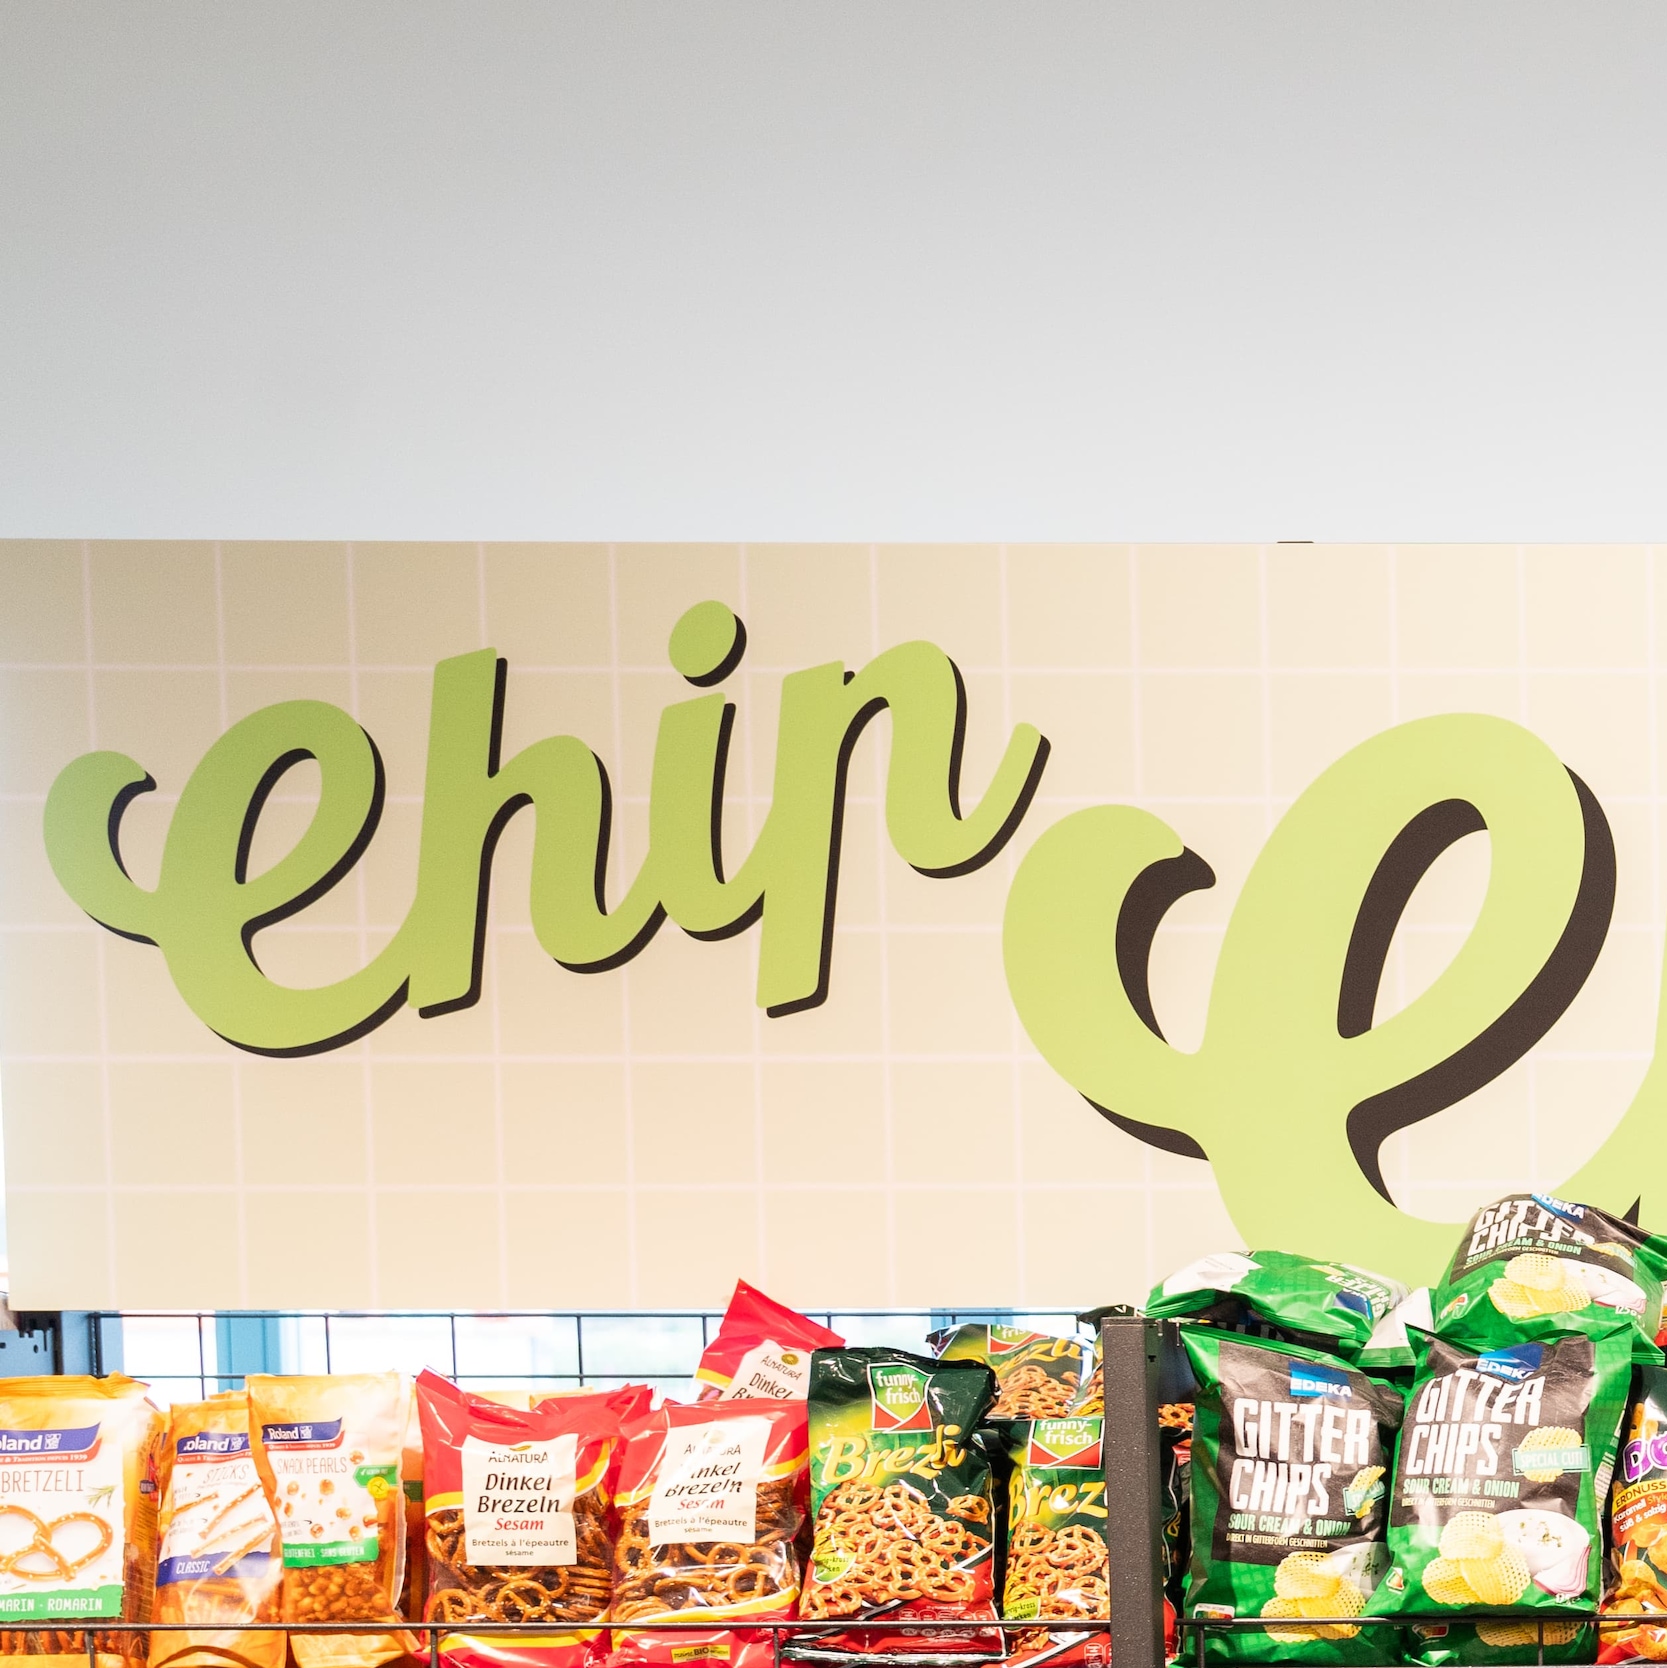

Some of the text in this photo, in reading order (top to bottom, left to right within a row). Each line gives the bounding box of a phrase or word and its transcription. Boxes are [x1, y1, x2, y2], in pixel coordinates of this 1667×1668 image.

[1290, 1380, 1352, 1396] EDEKA
[1414, 1370, 1542, 1426] GITTER
[823, 1425, 967, 1483] Brezli
[1404, 1423, 1502, 1476] CHIPS
[1520, 1451, 1586, 1467] SPECIAL CUT!
[277, 1455, 347, 1475] SNACK PEARLS
[484, 1473, 552, 1492] Dinkel
[1403, 1477, 1519, 1498] SOUR CREAM & ONION
[477, 1495, 560, 1516] Brezeln
[494, 1516, 544, 1532] Sesam
[472, 1538, 508, 1548] Bretzels
[512, 1538, 516, 1547] à
[505, 1549, 533, 1557] sésame
[47, 1596, 103, 1612] ROMARIN
